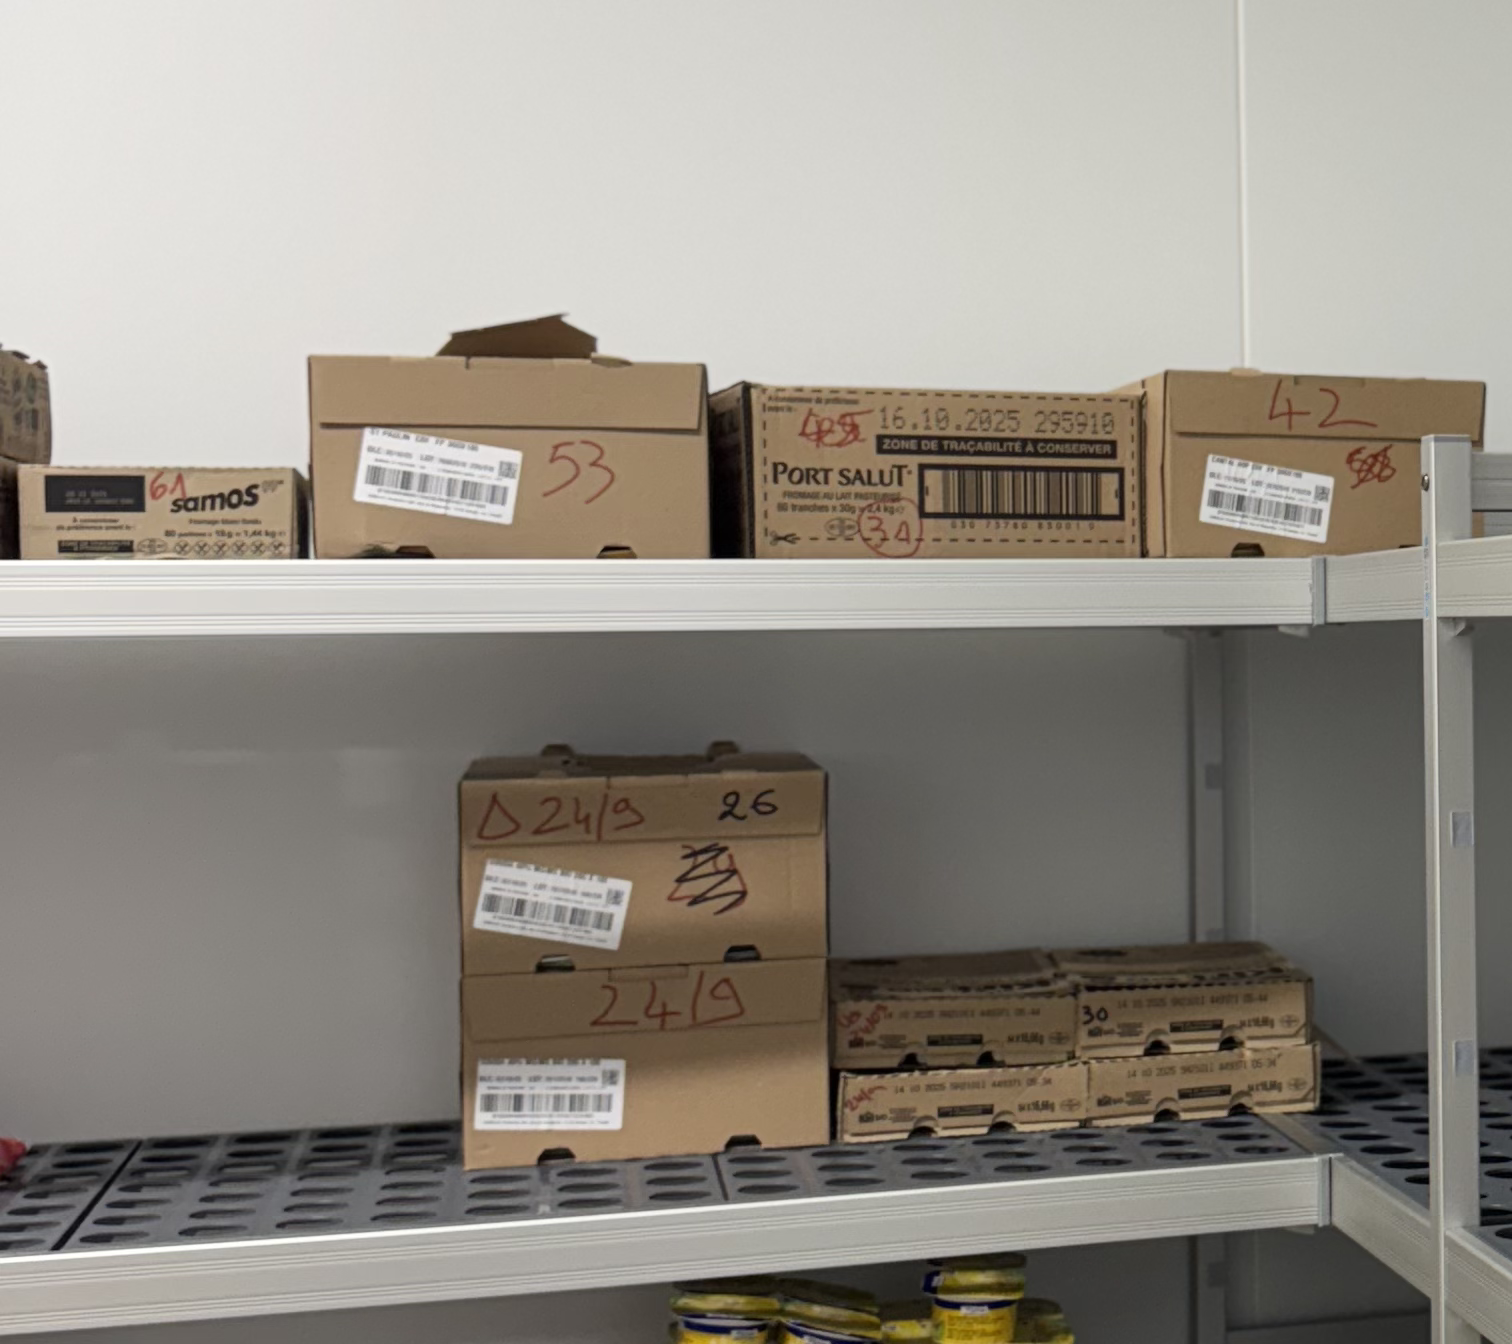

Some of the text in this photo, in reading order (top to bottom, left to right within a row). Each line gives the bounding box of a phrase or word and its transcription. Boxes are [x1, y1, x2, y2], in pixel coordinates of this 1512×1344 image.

[1268, 378, 1378, 432] 42
[879, 406, 1021, 433] 16.10.2025
[1034, 409, 1115, 435] 295910
[882, 439, 918, 451] ZONE
[921, 440, 939, 452] DE
[942, 439, 1022, 455] TRAÇABILITÉ
[1037, 442, 1112, 455] CONSERVER
[542, 440, 616, 503] 53
[772, 461, 908, 487] PORT SALUT
[170, 484, 259, 514] samos
[718, 789, 779, 821] 26
[1082, 1005, 1108, 1025] 30
